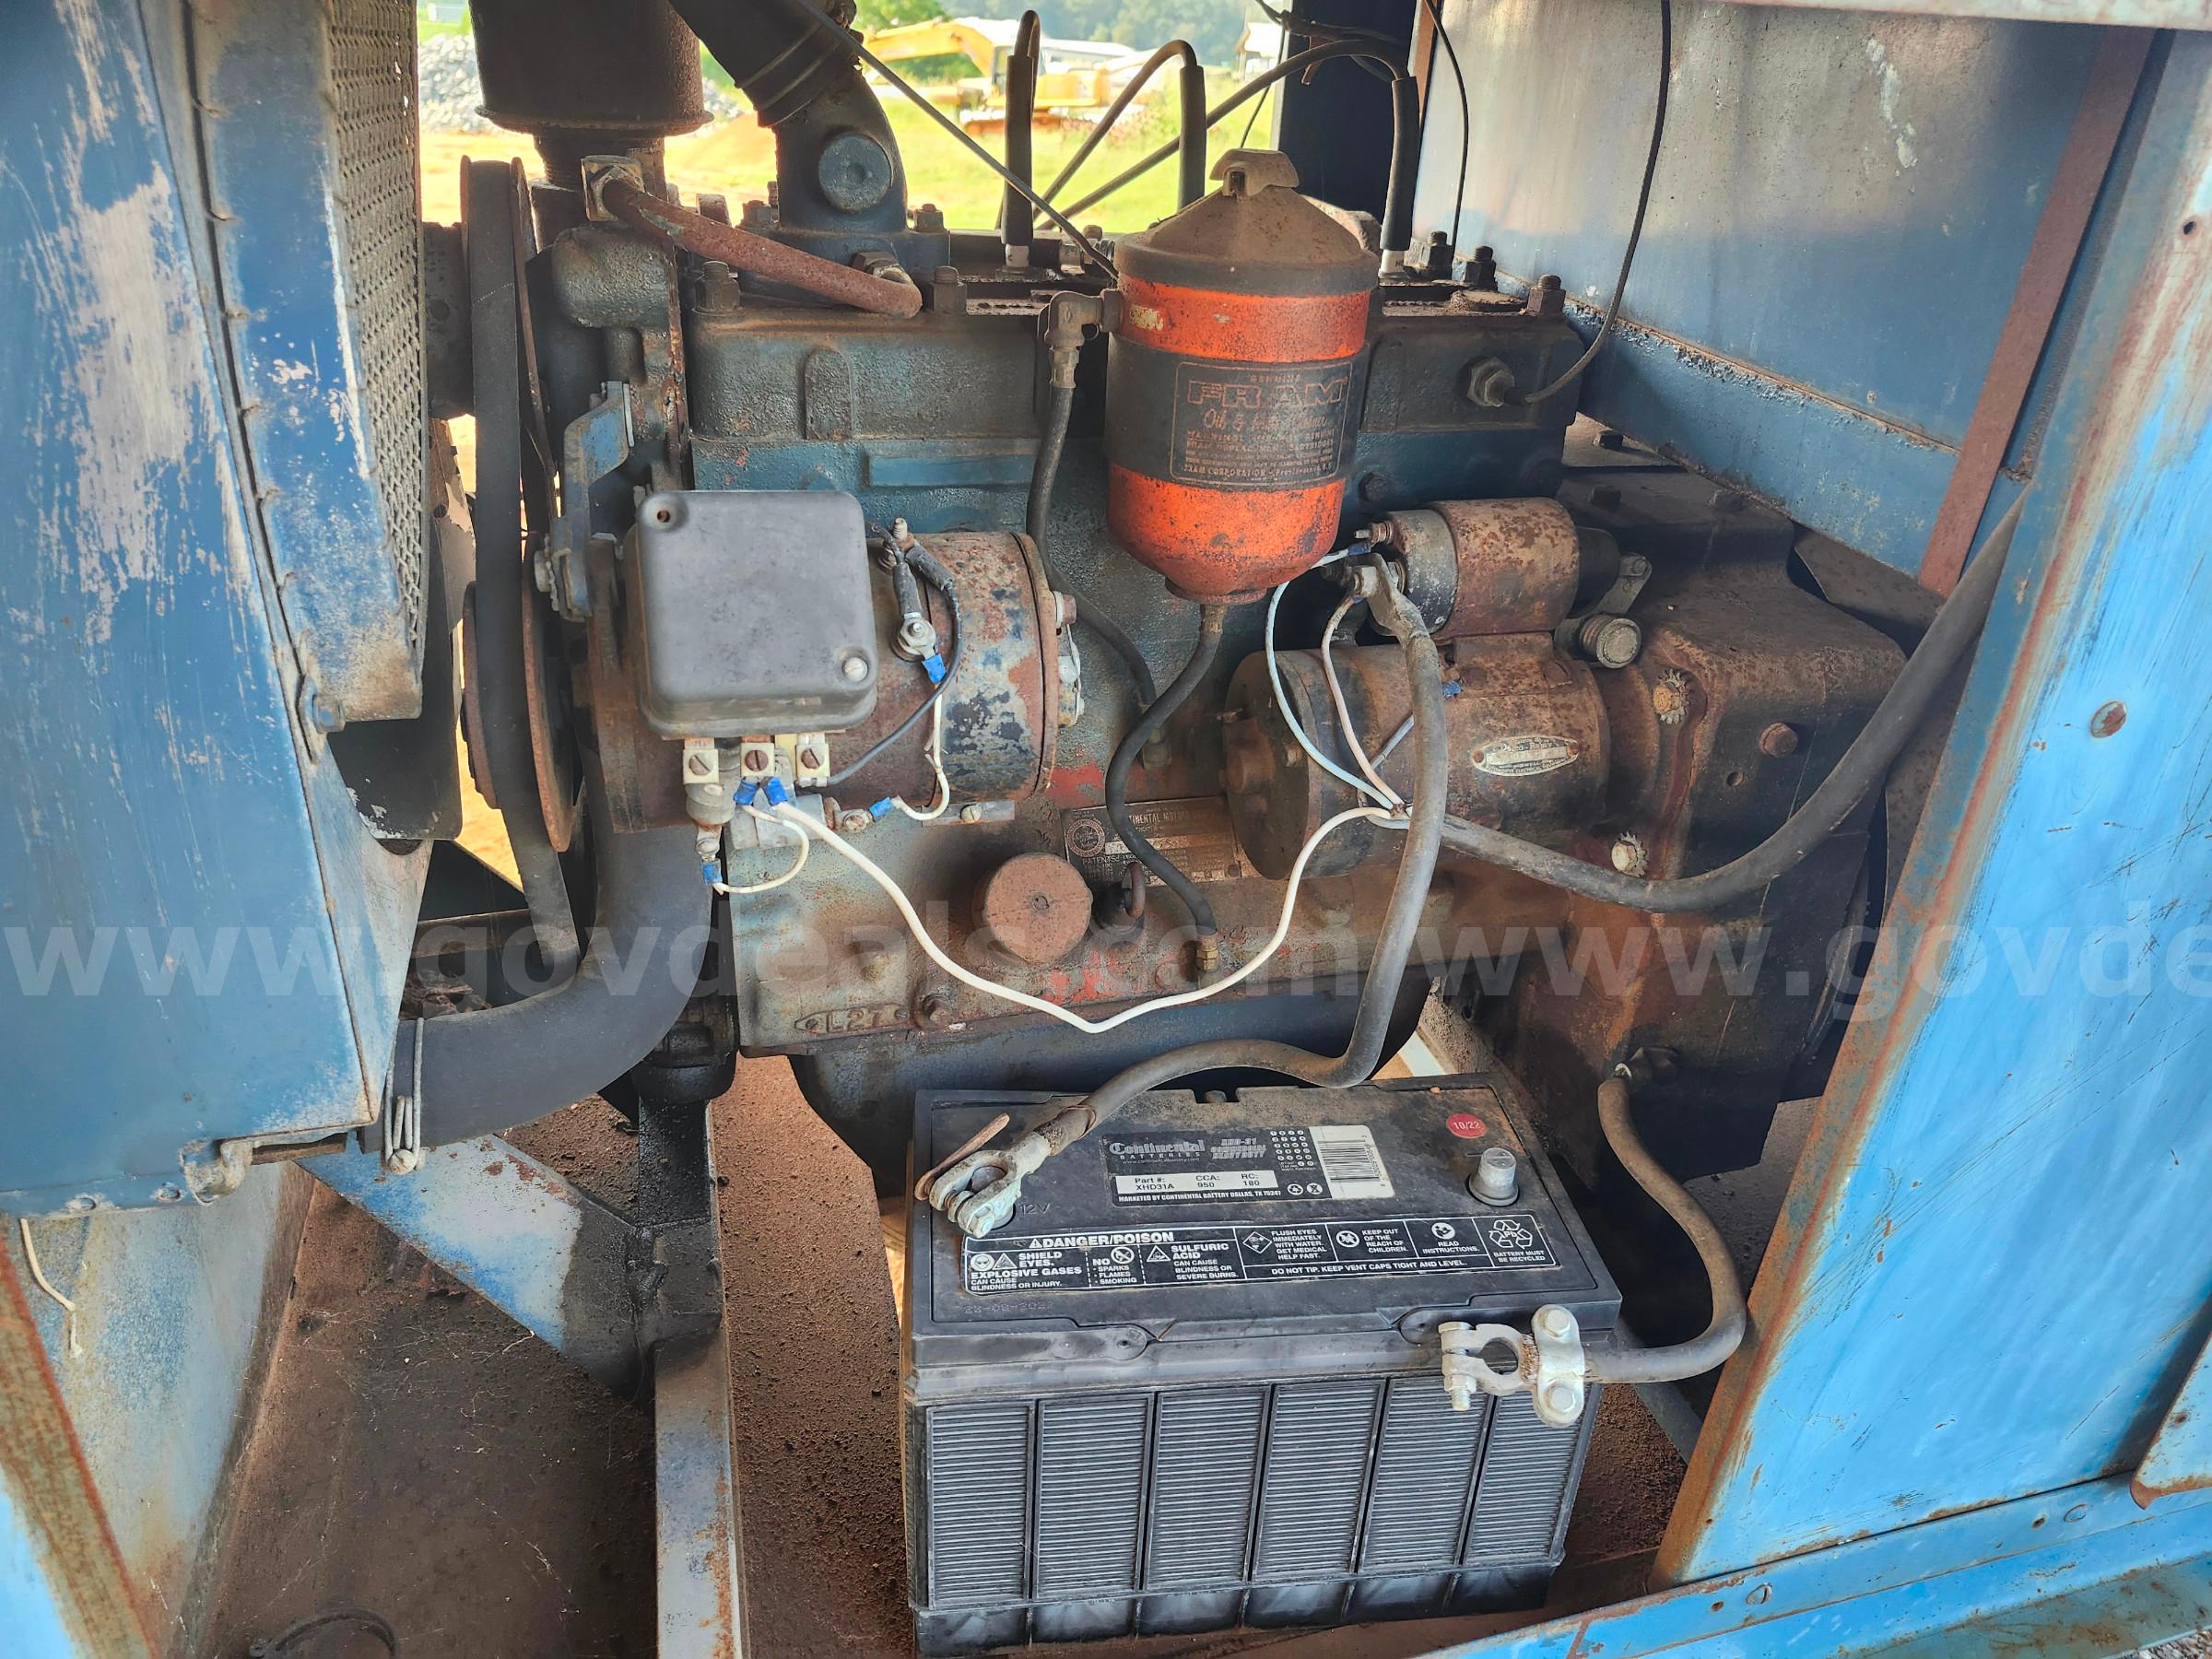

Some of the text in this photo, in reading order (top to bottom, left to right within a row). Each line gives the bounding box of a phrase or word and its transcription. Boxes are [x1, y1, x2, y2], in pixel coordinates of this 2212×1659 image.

[1187, 379, 1344, 408] FRAM
[1453, 1121, 1481, 1130] 10/22
[1109, 1139, 1206, 1155] Continental
[1042, 1231, 1174, 1247] DANGER/POISON
[1171, 1243, 1230, 1253] SULFURIC
[1422, 1246, 1480, 1254] INSTRUCTIONS.
[1018, 1252, 1062, 1261] SHIELD
[1172, 1252, 1201, 1260] ACID
[1018, 1259, 1054, 1267] EYES.
[971, 1266, 1082, 1279] EXPLOSIVE GASES
